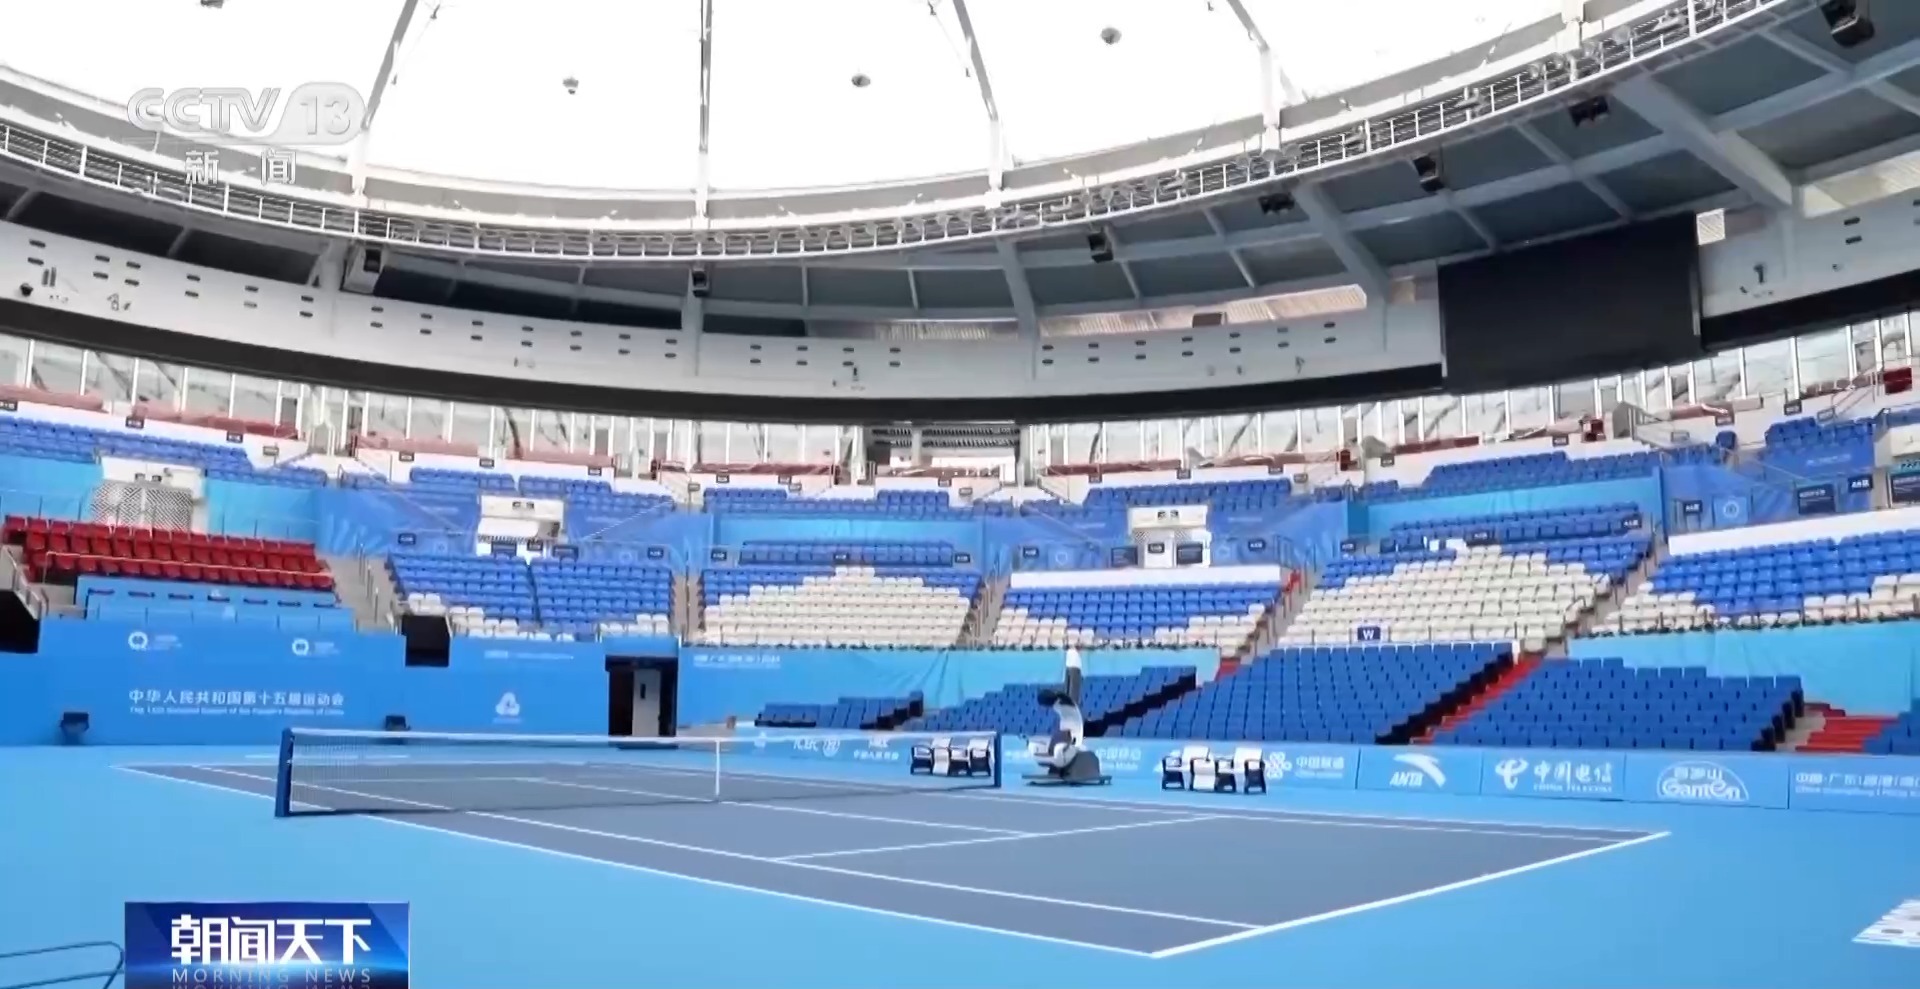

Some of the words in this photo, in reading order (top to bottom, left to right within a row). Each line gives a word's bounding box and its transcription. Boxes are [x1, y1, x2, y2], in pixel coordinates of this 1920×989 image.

[1363, 629, 1374, 640] W
[1390, 771, 1423, 787] ANTA
[1534, 760, 1612, 784] 中国电信
